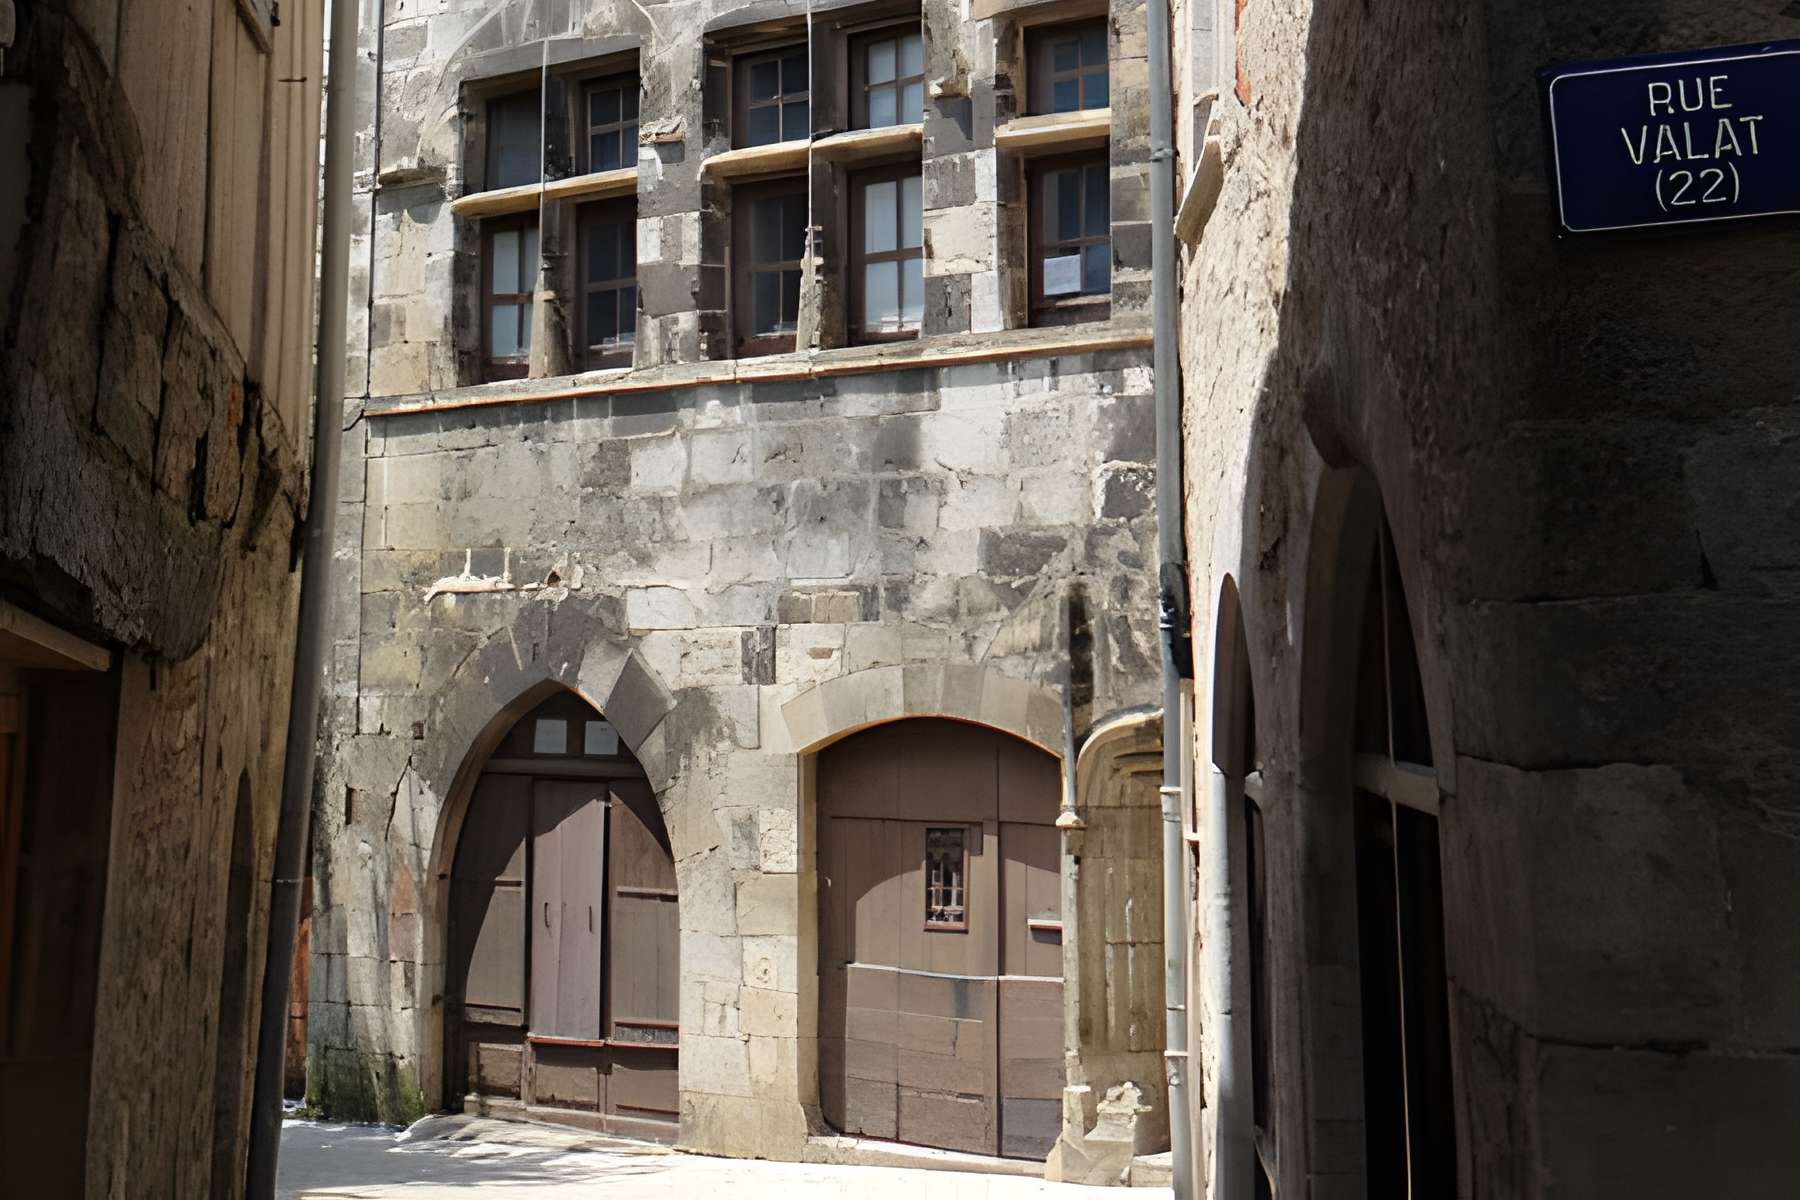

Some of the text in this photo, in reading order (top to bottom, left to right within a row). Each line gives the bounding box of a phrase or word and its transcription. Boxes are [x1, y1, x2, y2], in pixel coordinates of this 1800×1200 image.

[1648, 75, 1732, 116] RUE
[1621, 115, 1763, 165] VALAT
[1655, 162, 1740, 212] (22)
